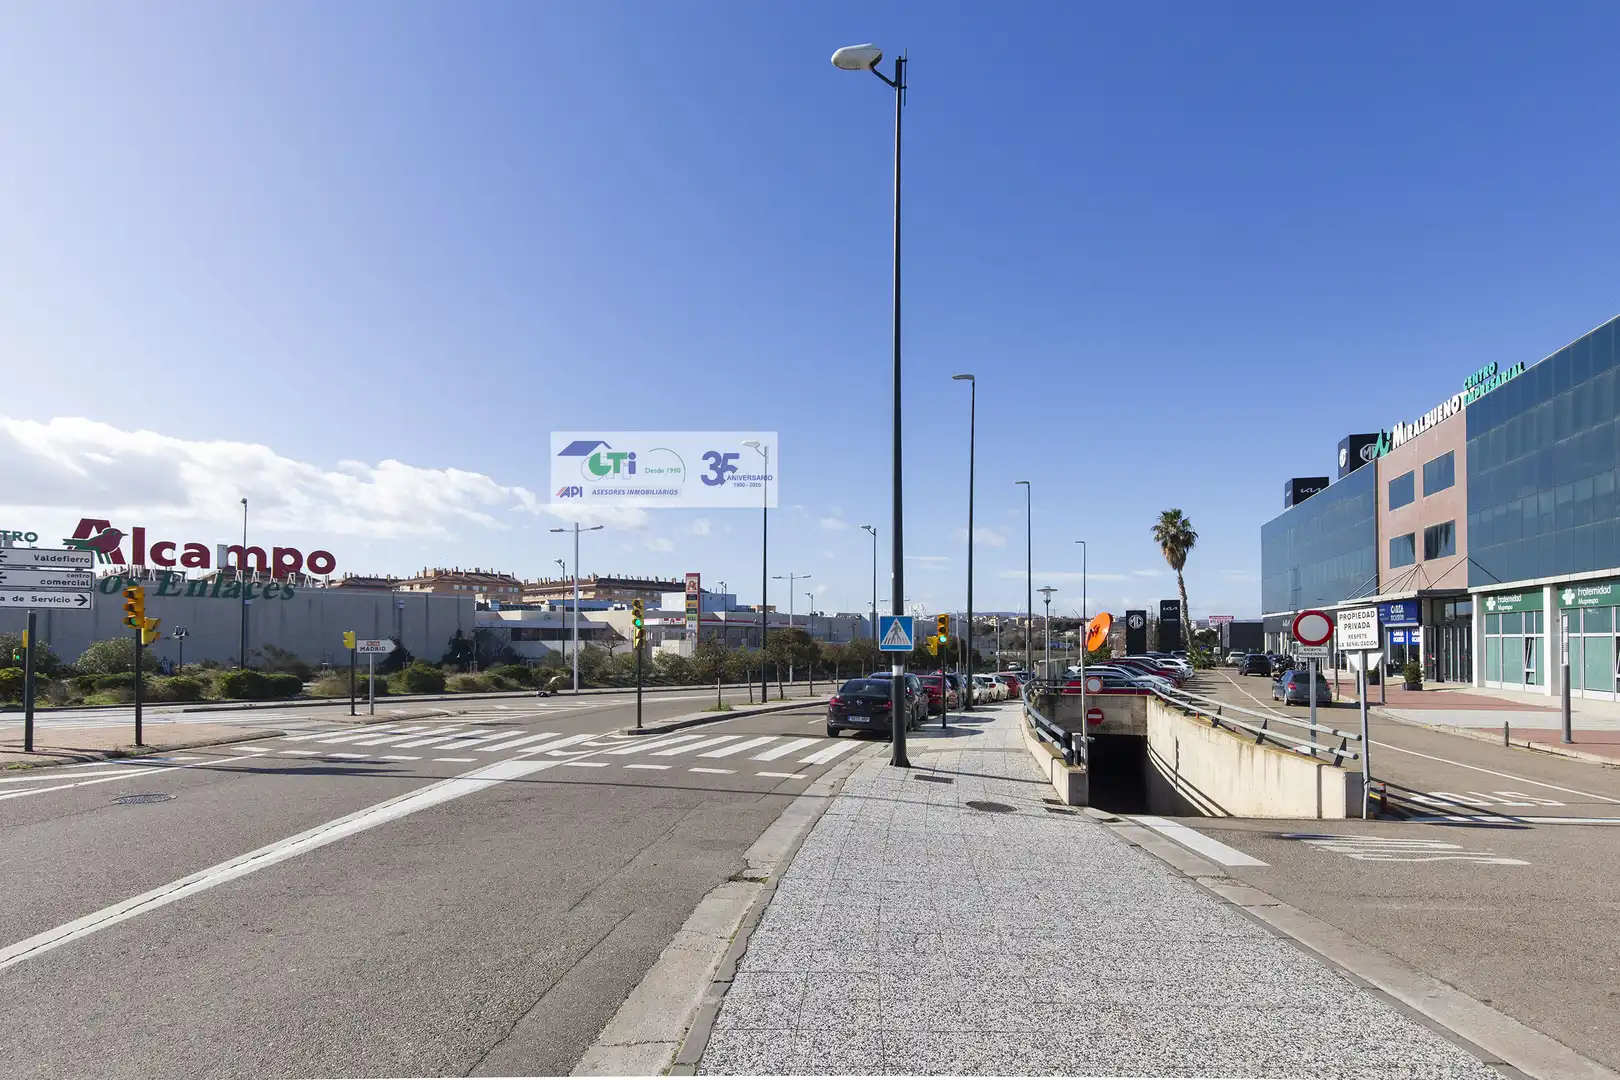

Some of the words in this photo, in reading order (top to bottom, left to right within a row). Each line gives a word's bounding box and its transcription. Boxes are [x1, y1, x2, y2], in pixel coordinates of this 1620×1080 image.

[1463, 362, 1497, 391] CENTRO
[1463, 361, 1524, 406] EMPRESARIAL
[34, 554, 90, 563] Valdefierro
[152, 570, 296, 600] Enlaces
[31, 595, 71, 603] Servicio
[1339, 610, 1375, 620] PROPIEDAD
[1344, 621, 1371, 630] PRIVADA
